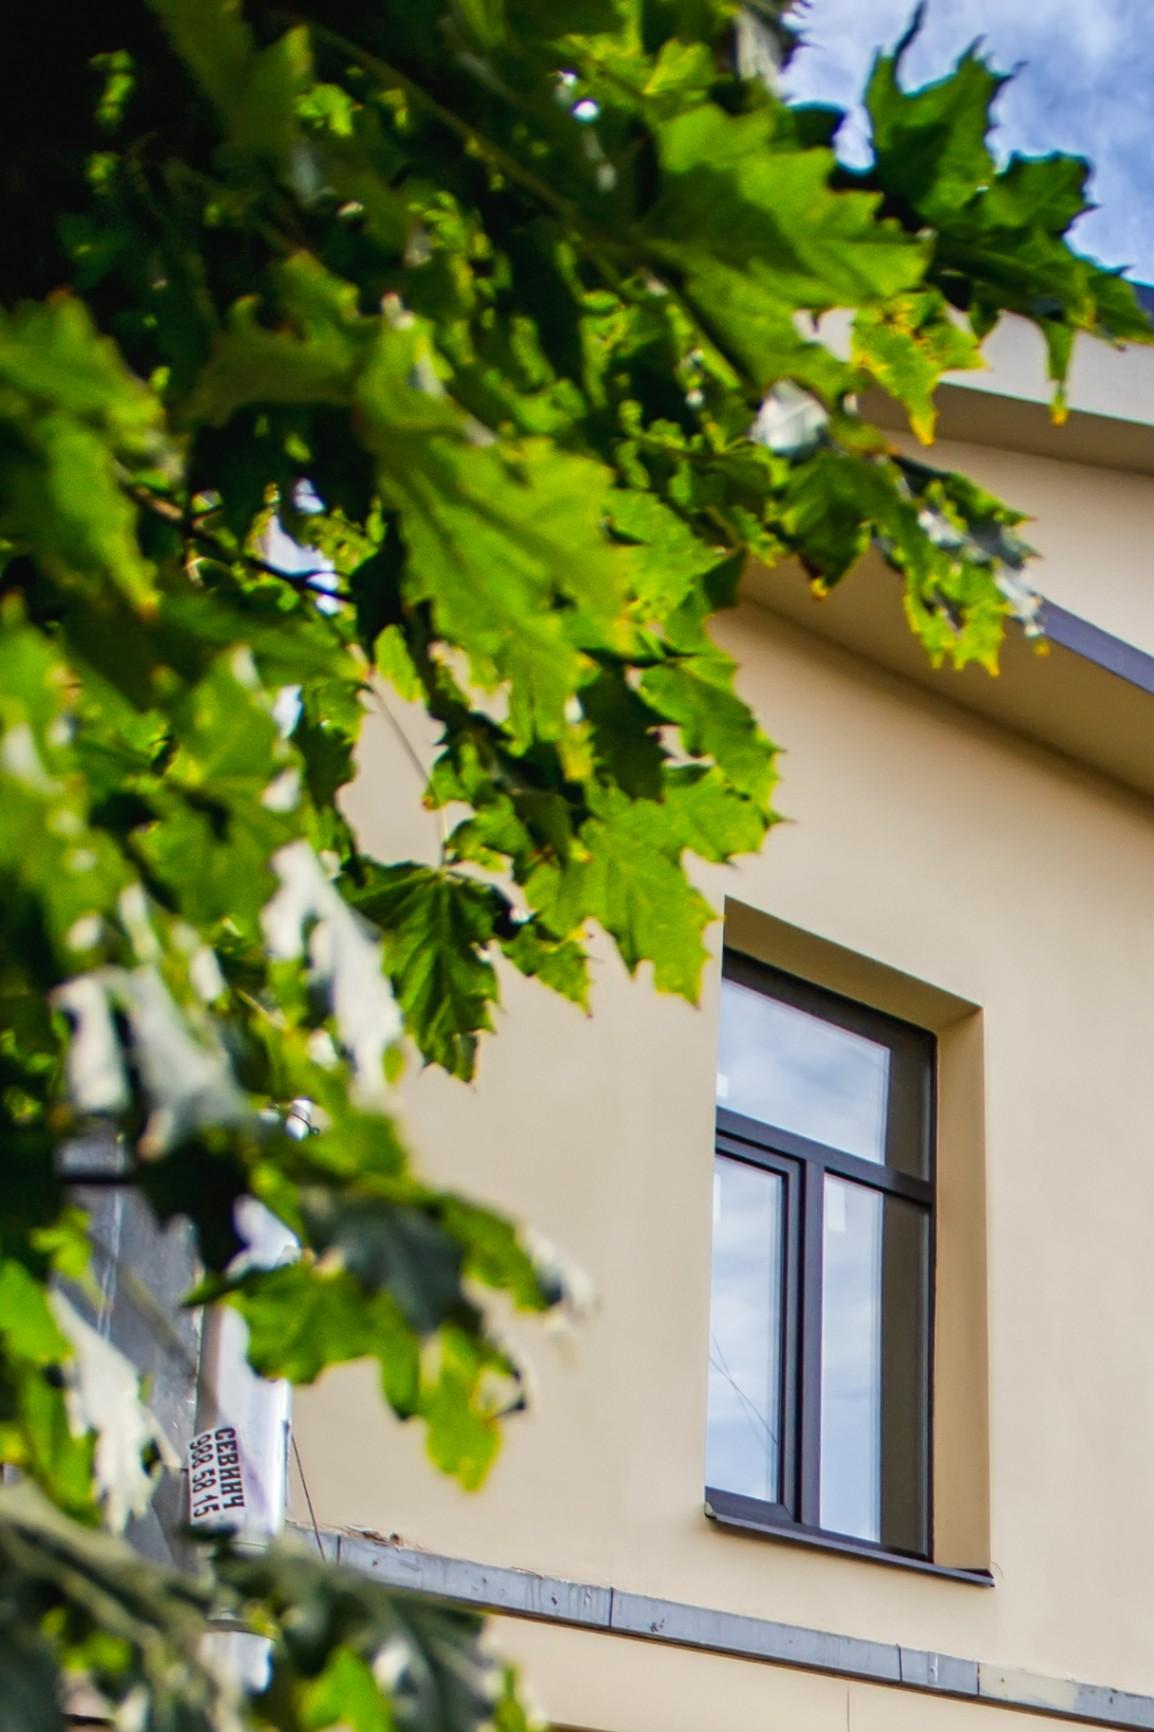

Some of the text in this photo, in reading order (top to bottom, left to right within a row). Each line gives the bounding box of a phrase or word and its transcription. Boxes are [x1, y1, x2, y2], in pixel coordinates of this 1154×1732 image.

[215, 1427, 245, 1509] СЕВИНЧ
[192, 1469, 216, 1493] 58
[193, 1495, 220, 1518] 15
